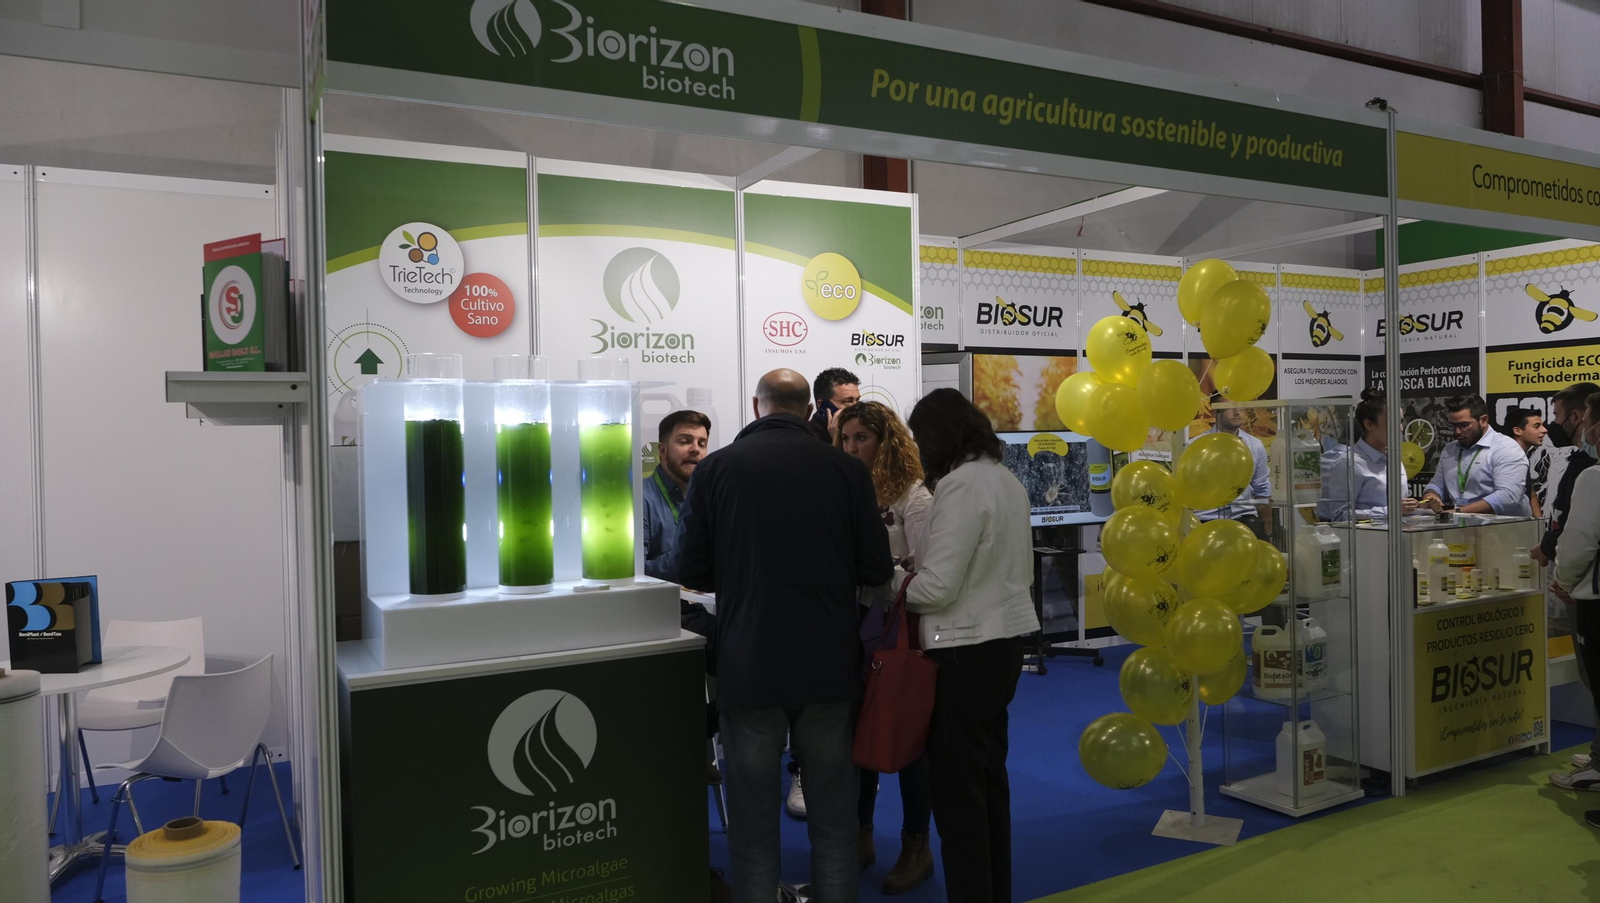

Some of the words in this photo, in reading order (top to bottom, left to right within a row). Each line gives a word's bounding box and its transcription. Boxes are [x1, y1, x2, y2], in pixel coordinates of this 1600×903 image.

[550, 0, 735, 77] Biorizon
[642, 66, 736, 101] biotech
[870, 69, 916, 103] Por
[925, 84, 976, 113] una
[982, 91, 1117, 133] agricultura
[1121, 115, 1227, 150] sostenible
[1230, 131, 1243, 159] y
[1245, 133, 1344, 168] productiva
[1472, 164, 1584, 204] Comprometidos
[403, 286, 443, 296] Technology
[463, 284, 498, 297] 100%
[820, 283, 857, 299] eco
[460, 298, 504, 312] Cultivo
[467, 312, 499, 325] Sano
[976, 301, 1063, 328] BIOSUR
[590, 318, 695, 354] Biorizon
[768, 320, 803, 338] SHC
[980, 328, 1030, 336] DISTRIBUIDOR
[851, 333, 905, 347] BIOSUR
[641, 350, 695, 363] biotech
[1508, 355, 1574, 373] Fungicida
[1284, 367, 1307, 375] ASEGURA
[1315, 367, 1346, 376] PRODUCCIÓN
[1420, 366, 1448, 377] Perfecta
[1449, 365, 1471, 374] contra
[1513, 370, 1600, 385] Trichoderma
[1294, 378, 1303, 386] LOS
[1304, 378, 1328, 386] MEJORES
[1328, 378, 1348, 386] ALIADOS
[1399, 377, 1424, 390] OSCA
[1427, 375, 1472, 388] BLANCA
[1437, 614, 1476, 631] CONTROL
[1477, 607, 1520, 624] BIOLÓGICO
[1520, 605, 1526, 616] Y
[1427, 633, 1478, 653] PRODUCTOS
[1479, 627, 1514, 643] RESIDUO
[1514, 623, 1535, 636] CERO
[1264, 672, 1281, 682] Biofat
[1431, 648, 1534, 703] BIOSUR
[1438, 696, 1488, 714] INGENIERÍA
[1491, 688, 1527, 702] NATURAL
[470, 797, 617, 855] Biorizon
[543, 821, 618, 851] biotech
[464, 876, 537, 903] Growing
[541, 857, 629, 886] Microalgae
